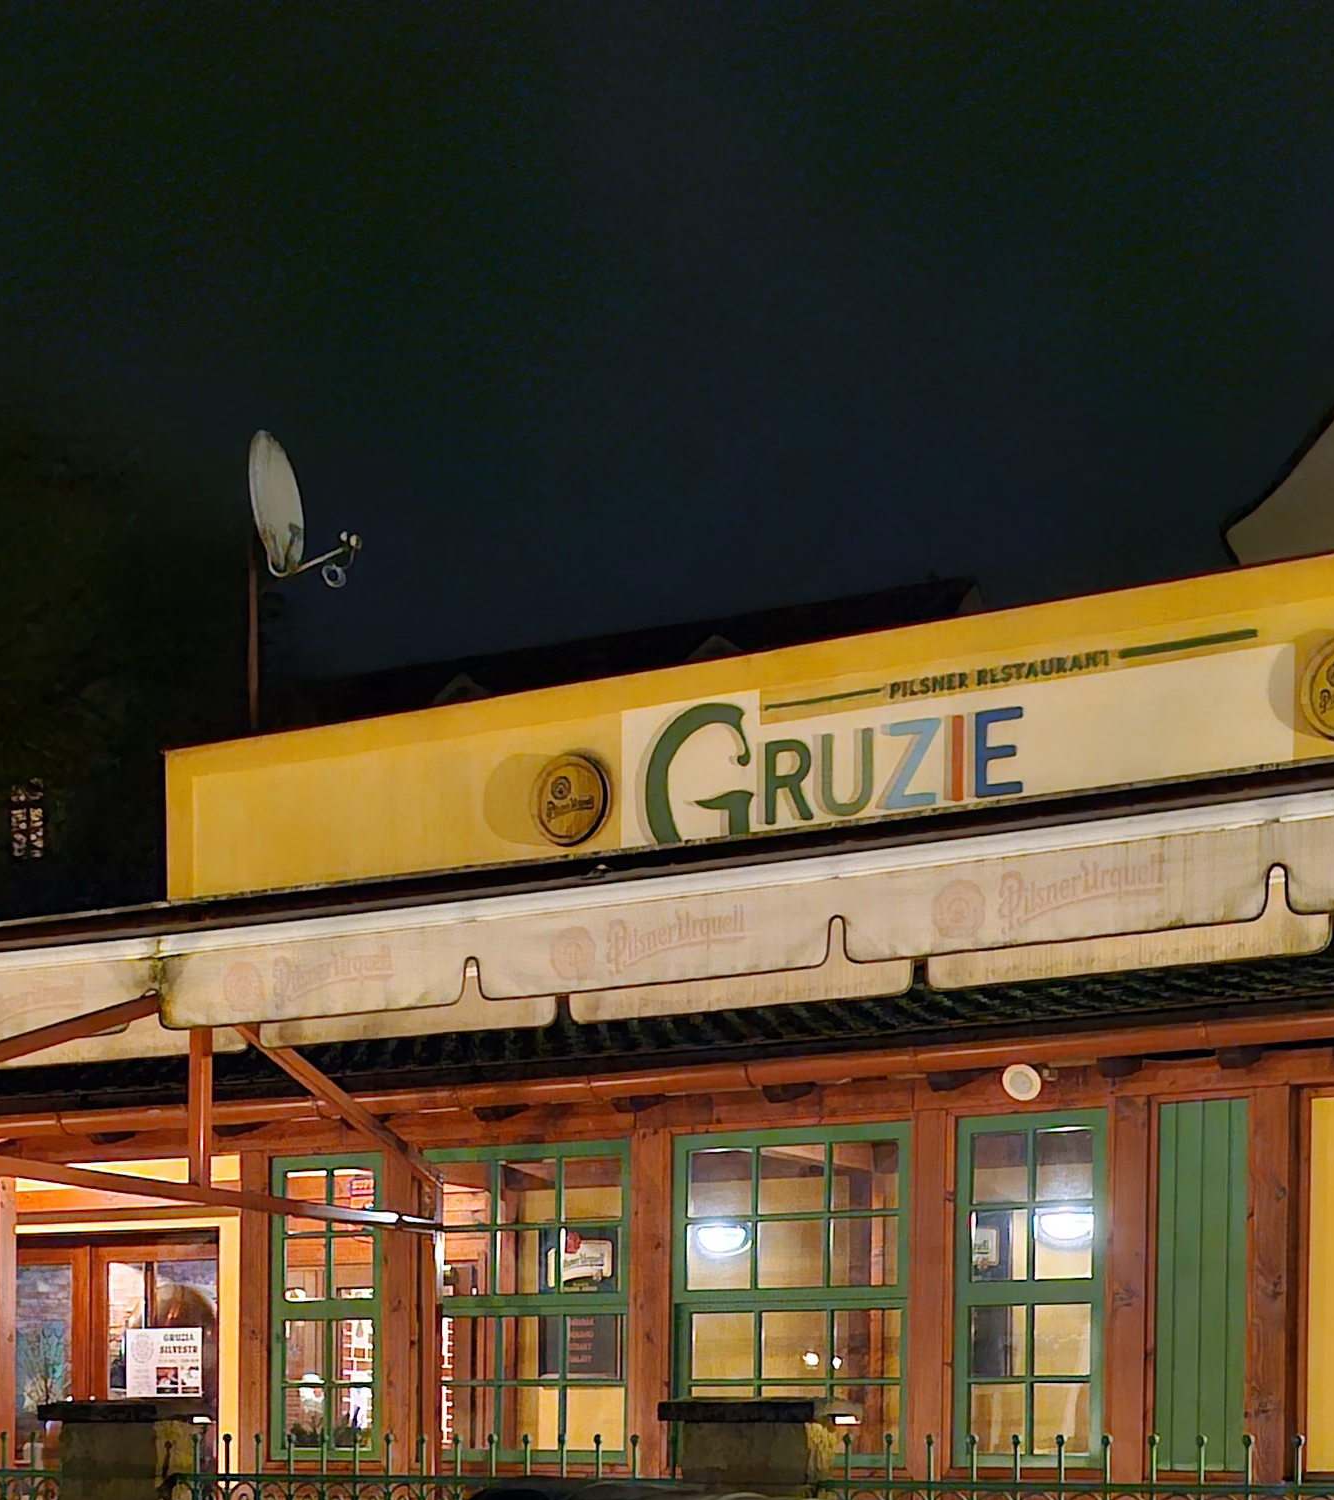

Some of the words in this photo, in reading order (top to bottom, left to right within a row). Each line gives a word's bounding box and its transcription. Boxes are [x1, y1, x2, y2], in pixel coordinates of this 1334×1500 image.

[889, 672, 969, 699] PILSNER
[977, 650, 1110, 686] RESTAURANT
[643, 702, 1024, 845] GRUZIE
[997, 870, 1081, 934] Pilsner
[1080, 852, 1165, 900] Urquell
[606, 918, 676, 976] Pilsner
[674, 904, 745, 950] Urquell
